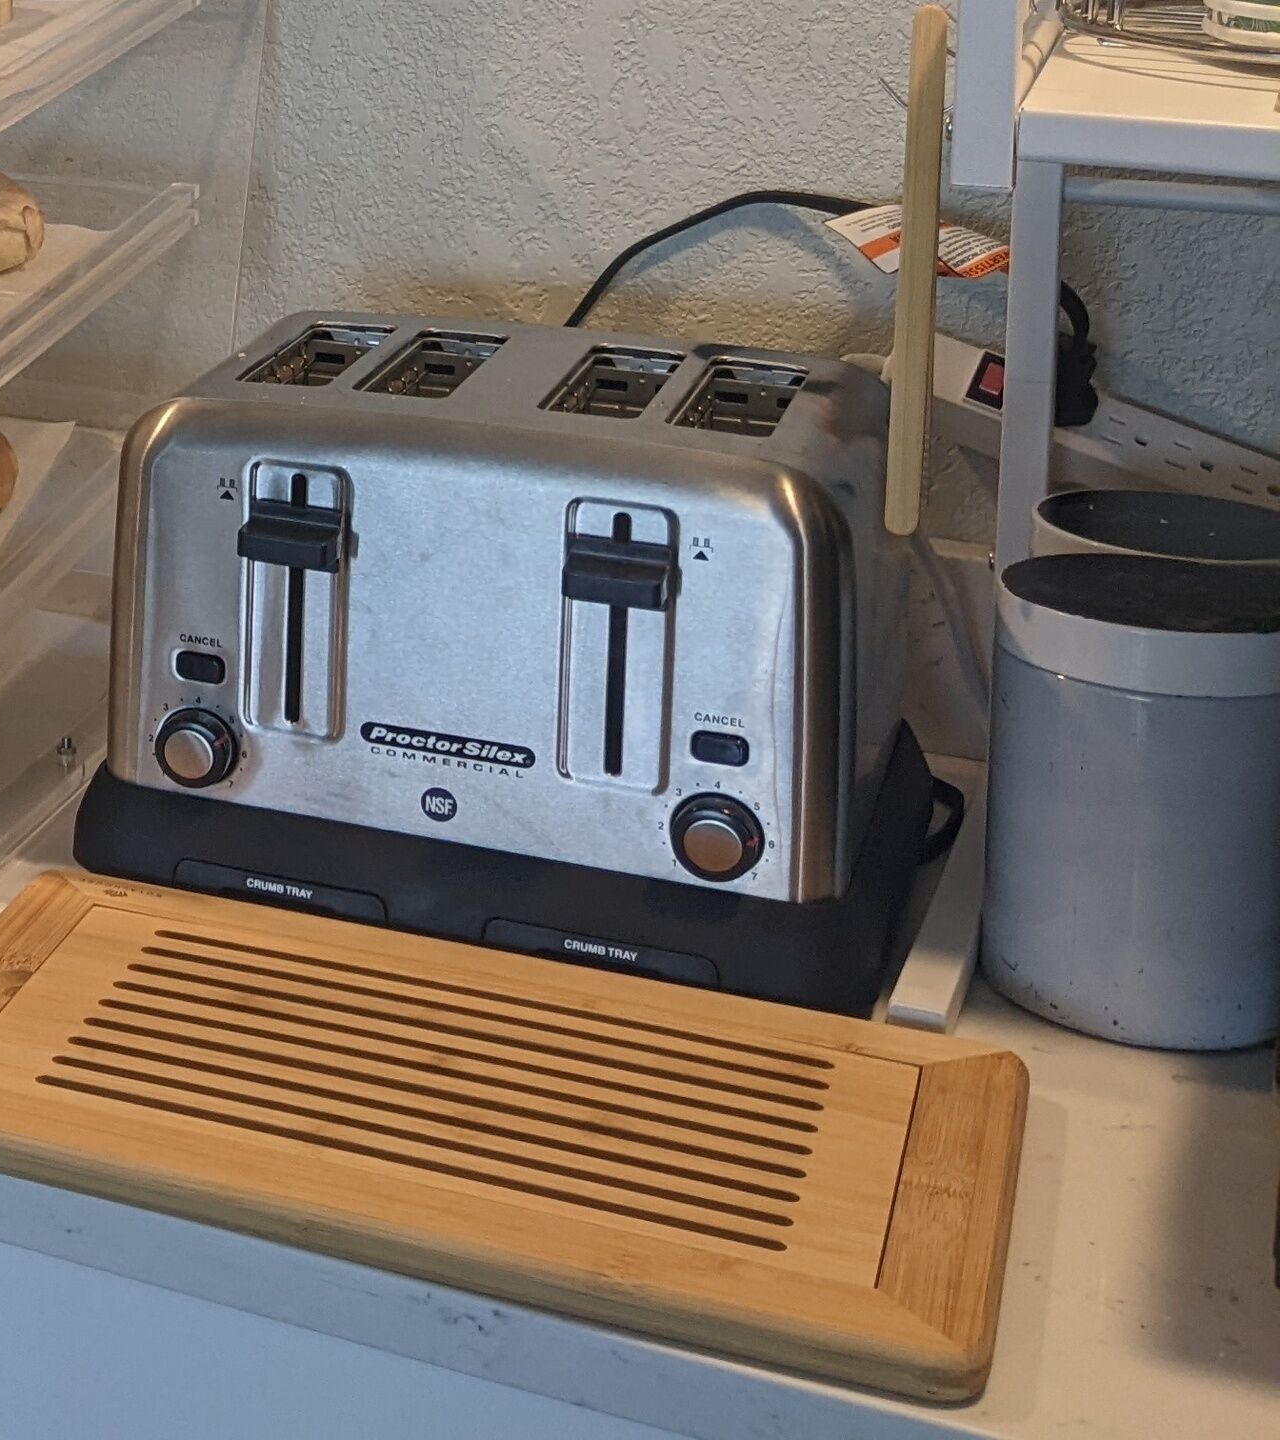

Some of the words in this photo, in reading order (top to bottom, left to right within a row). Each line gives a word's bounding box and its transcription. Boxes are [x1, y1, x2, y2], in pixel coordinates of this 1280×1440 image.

[179, 633, 222, 648] CANCEL
[195, 696, 201, 704] 4
[162, 703, 169, 711] 3
[694, 711, 745, 728] CANCEL
[148, 734, 154, 742] 2
[241, 750, 248, 759] 6
[370, 746, 524, 779] COMMERCIAL
[714, 780, 721, 789] 4
[675, 787, 682, 796] 3
[425, 795, 454, 815] NSF
[753, 802, 761, 811] 5
[657, 821, 665, 830] 2
[768, 840, 775, 849] 6
[751, 872, 758, 881] 7
[246, 878, 284, 894] CRUMB
[285, 885, 313, 900] TRAY
[563, 938, 606, 956] CRUMB
[607, 947, 638, 962] TRAY
